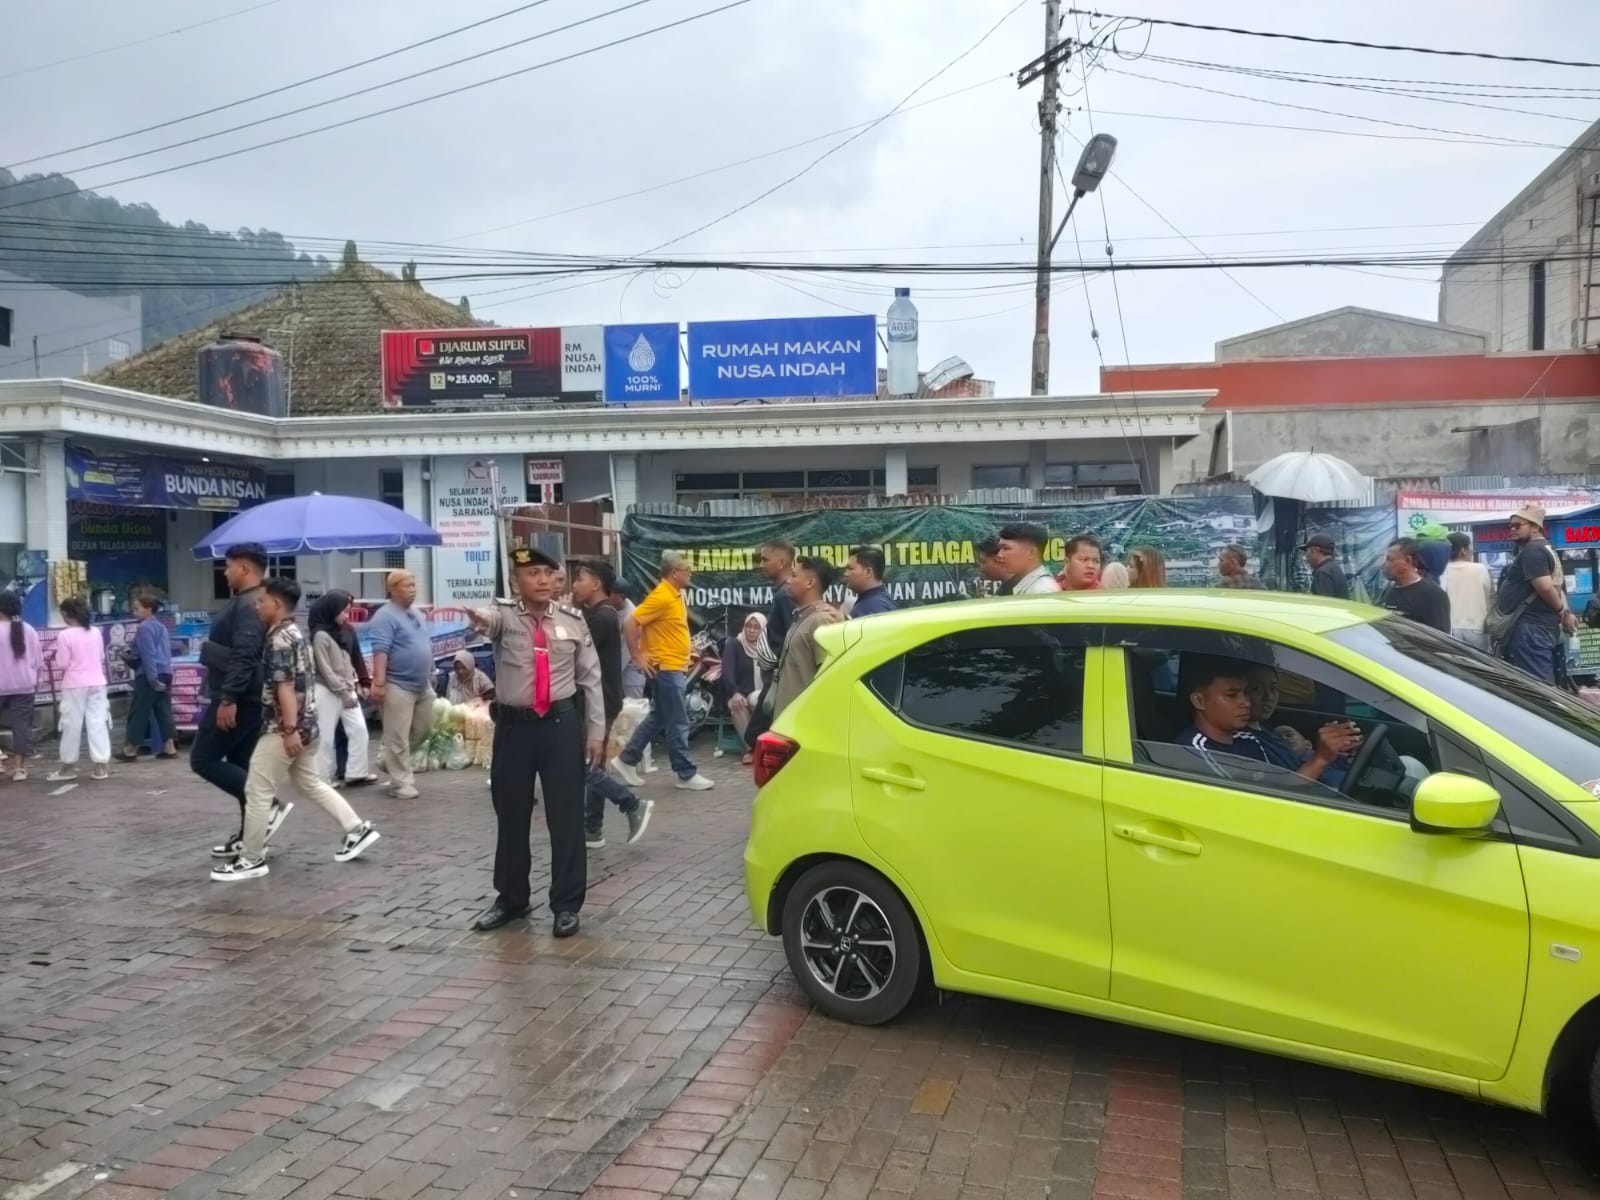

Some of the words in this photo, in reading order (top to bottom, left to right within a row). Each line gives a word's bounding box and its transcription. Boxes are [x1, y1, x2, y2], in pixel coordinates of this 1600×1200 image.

[891, 321, 915, 332] AQUA
[440, 341, 487, 353] DJARUM
[488, 339, 526, 351] SUPER
[564, 343, 582, 352] RM
[702, 342, 778, 358] RUMAH
[784, 340, 861, 356] MAKAN
[565, 353, 596, 363] NUSA
[565, 364, 601, 373] INDAH
[717, 364, 776, 379] NUSA
[780, 362, 846, 377] INDAH
[432, 375, 444, 386] 12
[627, 375, 659, 384] 100%
[625, 384, 661, 392] MURNI
[530, 462, 562, 471] TOILET
[165, 474, 219, 496] BUNDA
[221, 479, 265, 499] NISAN
[449, 487, 479, 496] SELAMAT
[480, 486, 507, 496] DATG
[439, 498, 461, 507] NUSA
[464, 497, 488, 506] INDAH
[452, 507, 498, 517] SARANGA
[465, 550, 490, 562] TOILET
[677, 548, 756, 572] LAMAT
[896, 540, 975, 567] TELAGA
[446, 579, 472, 588] TERIMA
[452, 590, 491, 599] KUNJUNGAN
[682, 587, 743, 607] MOHON
[749, 586, 774, 605] MA
[921, 580, 967, 600] ANDA
